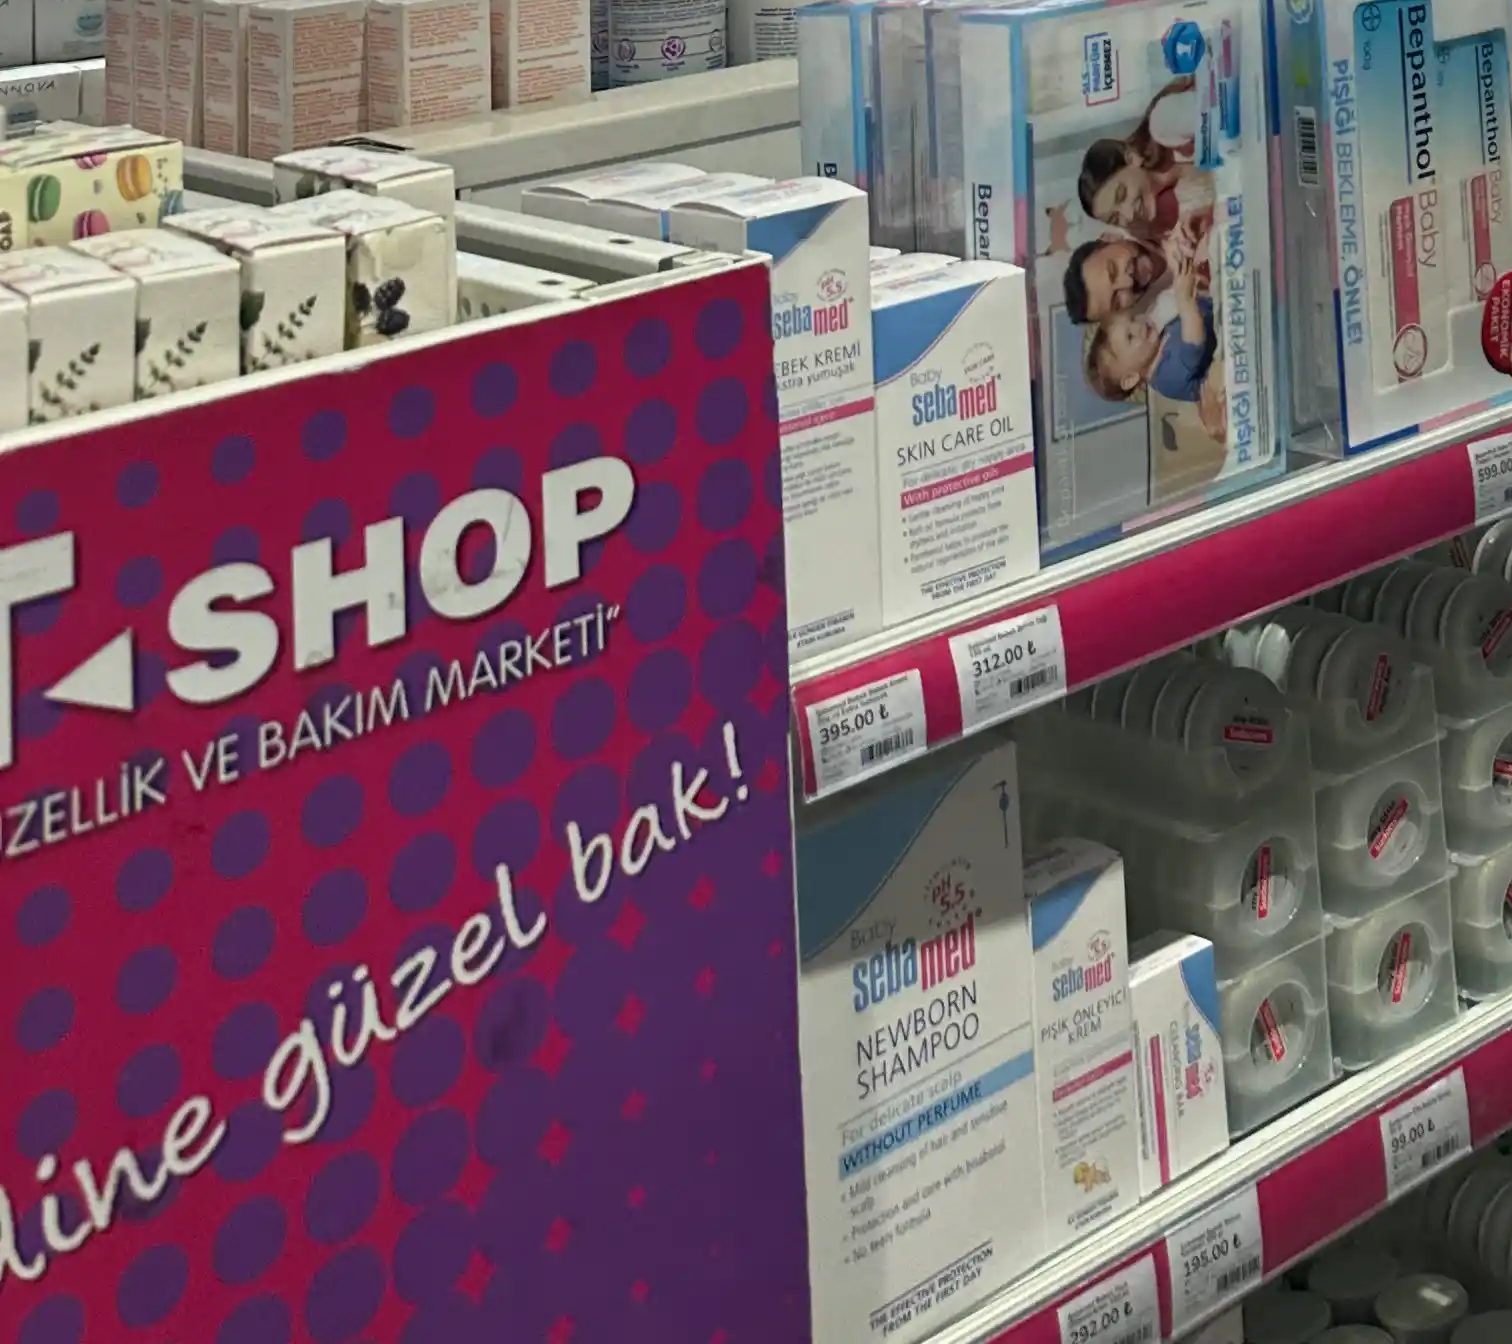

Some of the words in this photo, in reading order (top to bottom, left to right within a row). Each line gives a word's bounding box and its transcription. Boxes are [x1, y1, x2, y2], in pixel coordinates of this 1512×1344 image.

[1408, 3, 1435, 180] Bepanthol
[1480, 41, 1501, 163] Bepanthol
[1335, 142, 1359, 260] BEKLEME,
[1490, 169, 1504, 224] Baby
[1418, 189, 1438, 268] Baby
[773, 298, 849, 340] sebamed
[1488, 296, 1501, 345] PAKET
[909, 367, 943, 387] Baby
[912, 376, 998, 426] sebamed
[897, 439, 936, 467] SKIN
[941, 424, 985, 452] CARE
[990, 415, 1014, 437] OIL
[903, 490, 930, 505] With
[931, 474, 980, 499] protective
[1478, 458, 1512, 483] 599.00
[164, 455, 637, 705] SHOP
[972, 645, 1023, 677] 312.00
[183, 732, 241, 793] VE
[257, 679, 411, 770] BAKIM
[819, 710, 874, 745] 395.00
[940, 883, 965, 914] 5.5
[263, 862, 548, 1143] güzel
[567, 720, 749, 905] bak!
[851, 916, 897, 950] Baby
[853, 912, 976, 1013] sebamed
[1052, 954, 1112, 1003] sebamed
[857, 979, 977, 1066] NEWBORN
[1067, 1016, 1103, 1045] KREM
[858, 1012, 980, 1101] SHAMPOO
[841, 1126, 865, 1147] For
[869, 1089, 925, 1132] delicate
[928, 1069, 963, 1098] scalp
[843, 1117, 913, 1172] WITHOUT
[918, 1080, 983, 1130] PERFUME
[1391, 1123, 1425, 1154] 99.00
[938, 1246, 994, 1289] PROTECTION
[1183, 1240, 1228, 1278] 195.00
[883, 1311, 913, 1338] FROM
[935, 1279, 961, 1305] FIRST
[1069, 1307, 1119, 1344] 292.00
